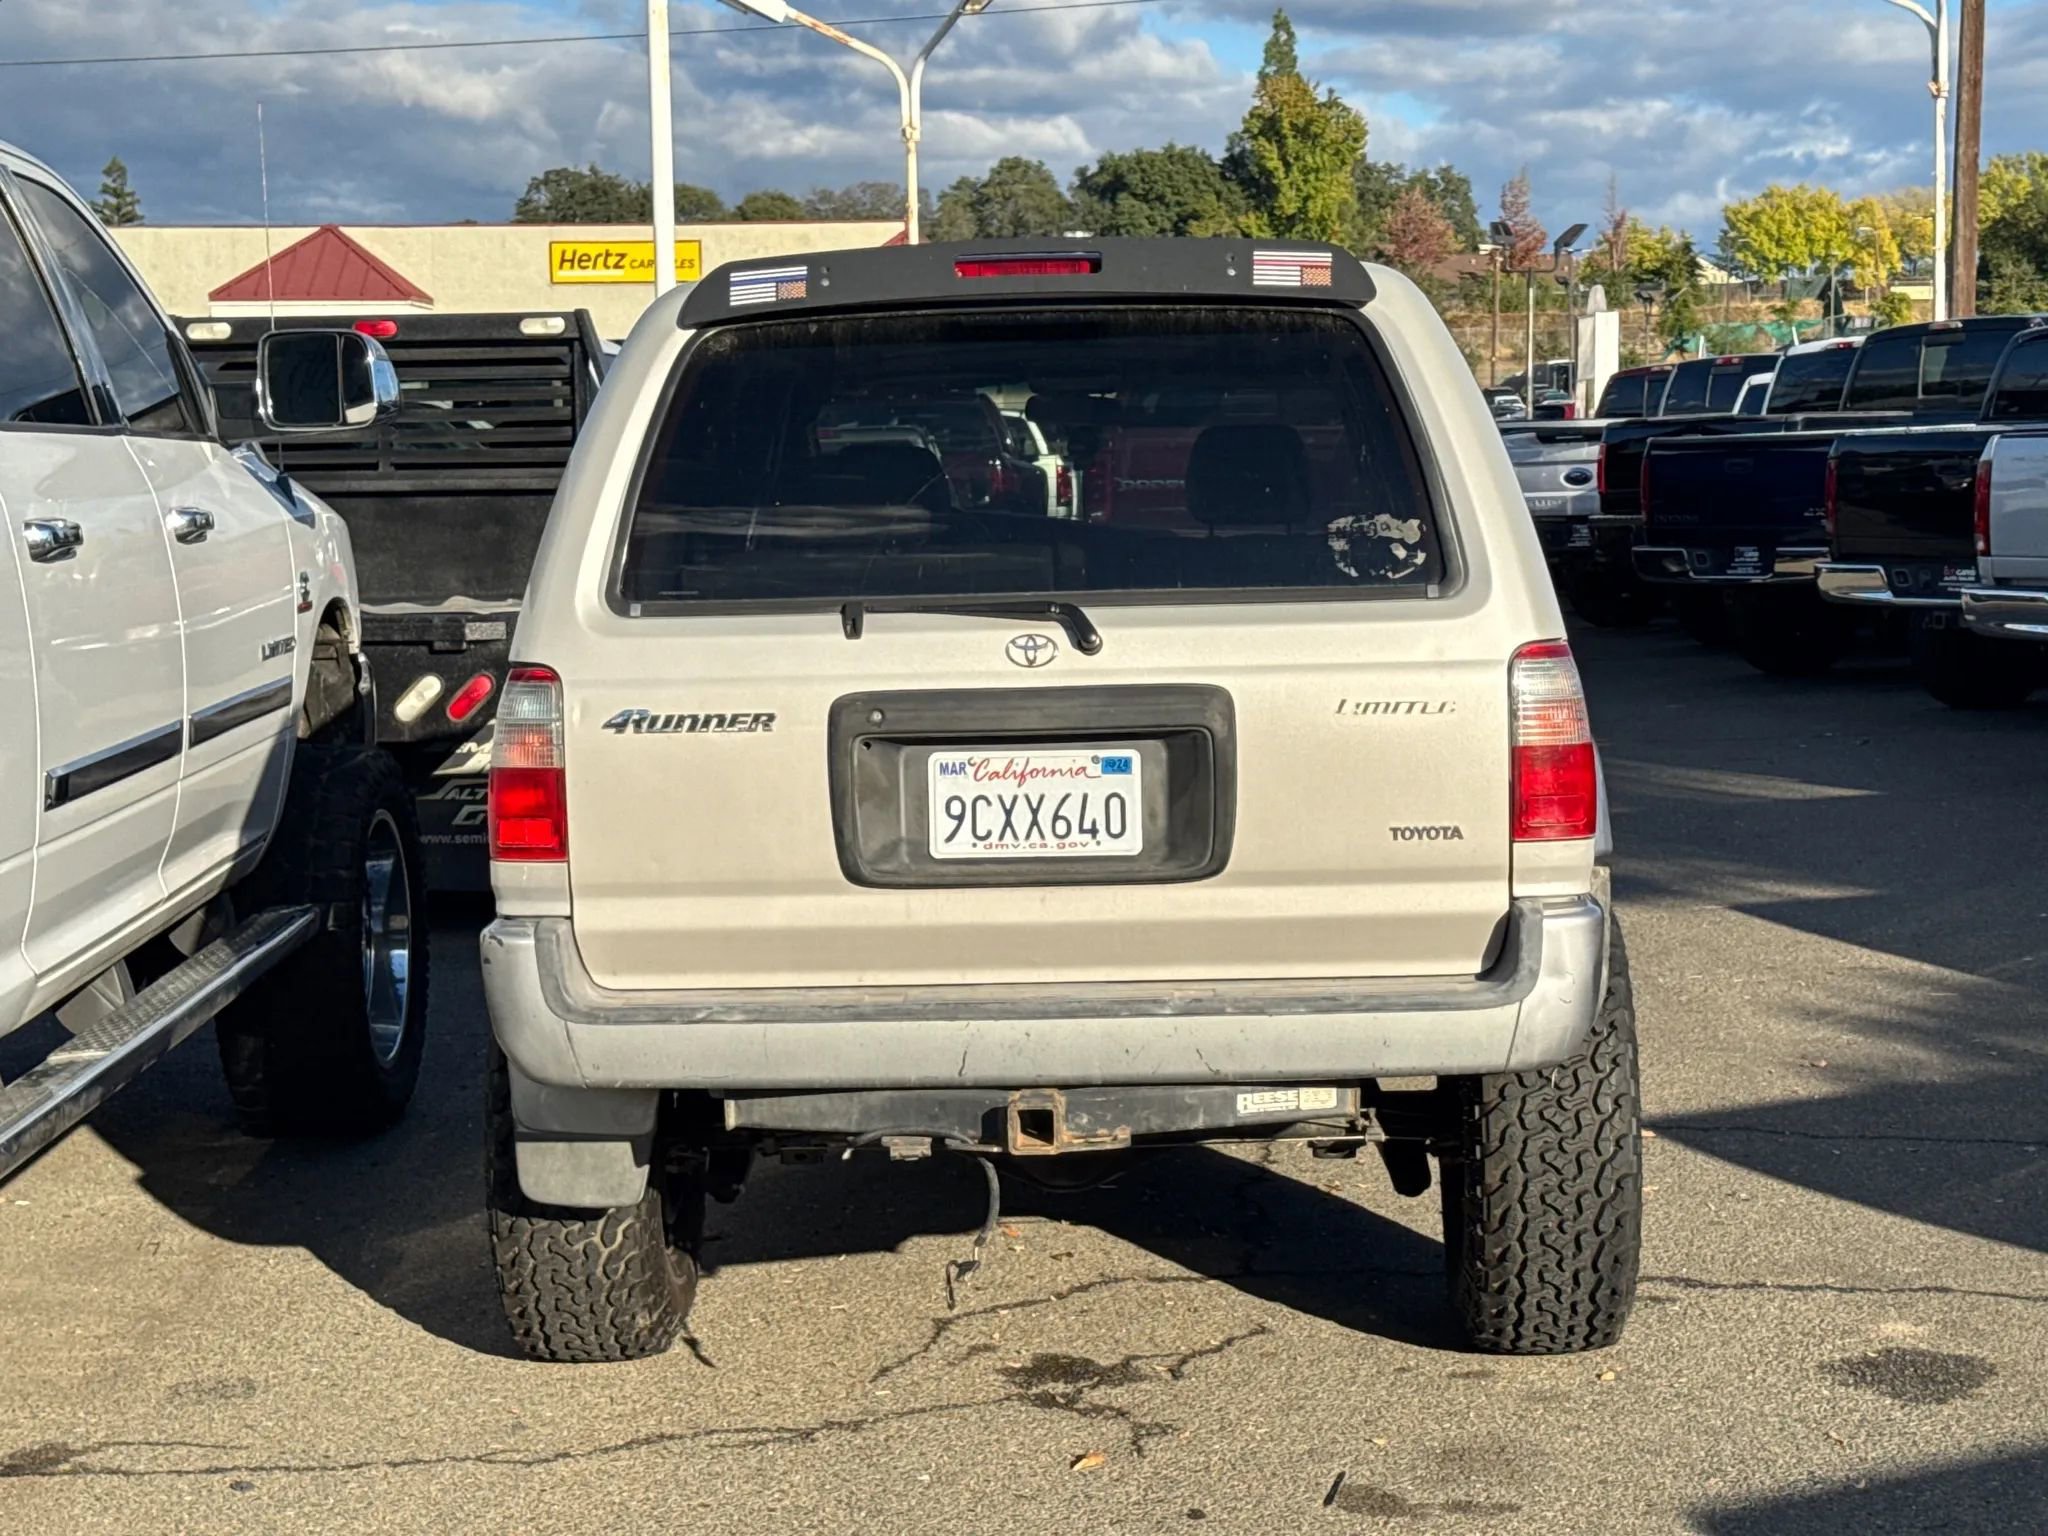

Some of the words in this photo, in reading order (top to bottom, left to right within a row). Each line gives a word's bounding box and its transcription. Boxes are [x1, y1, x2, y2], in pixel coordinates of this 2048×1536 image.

[559, 249, 627, 270] Hertz
[939, 761, 968, 776] MAR
[973, 757, 1102, 788] California
[944, 792, 1127, 844] 9CXX640
[421, 834, 490, 844] www.semi
[1388, 825, 1464, 841] TOYOTA
[983, 840, 1090, 851] dmv.ca.gov
